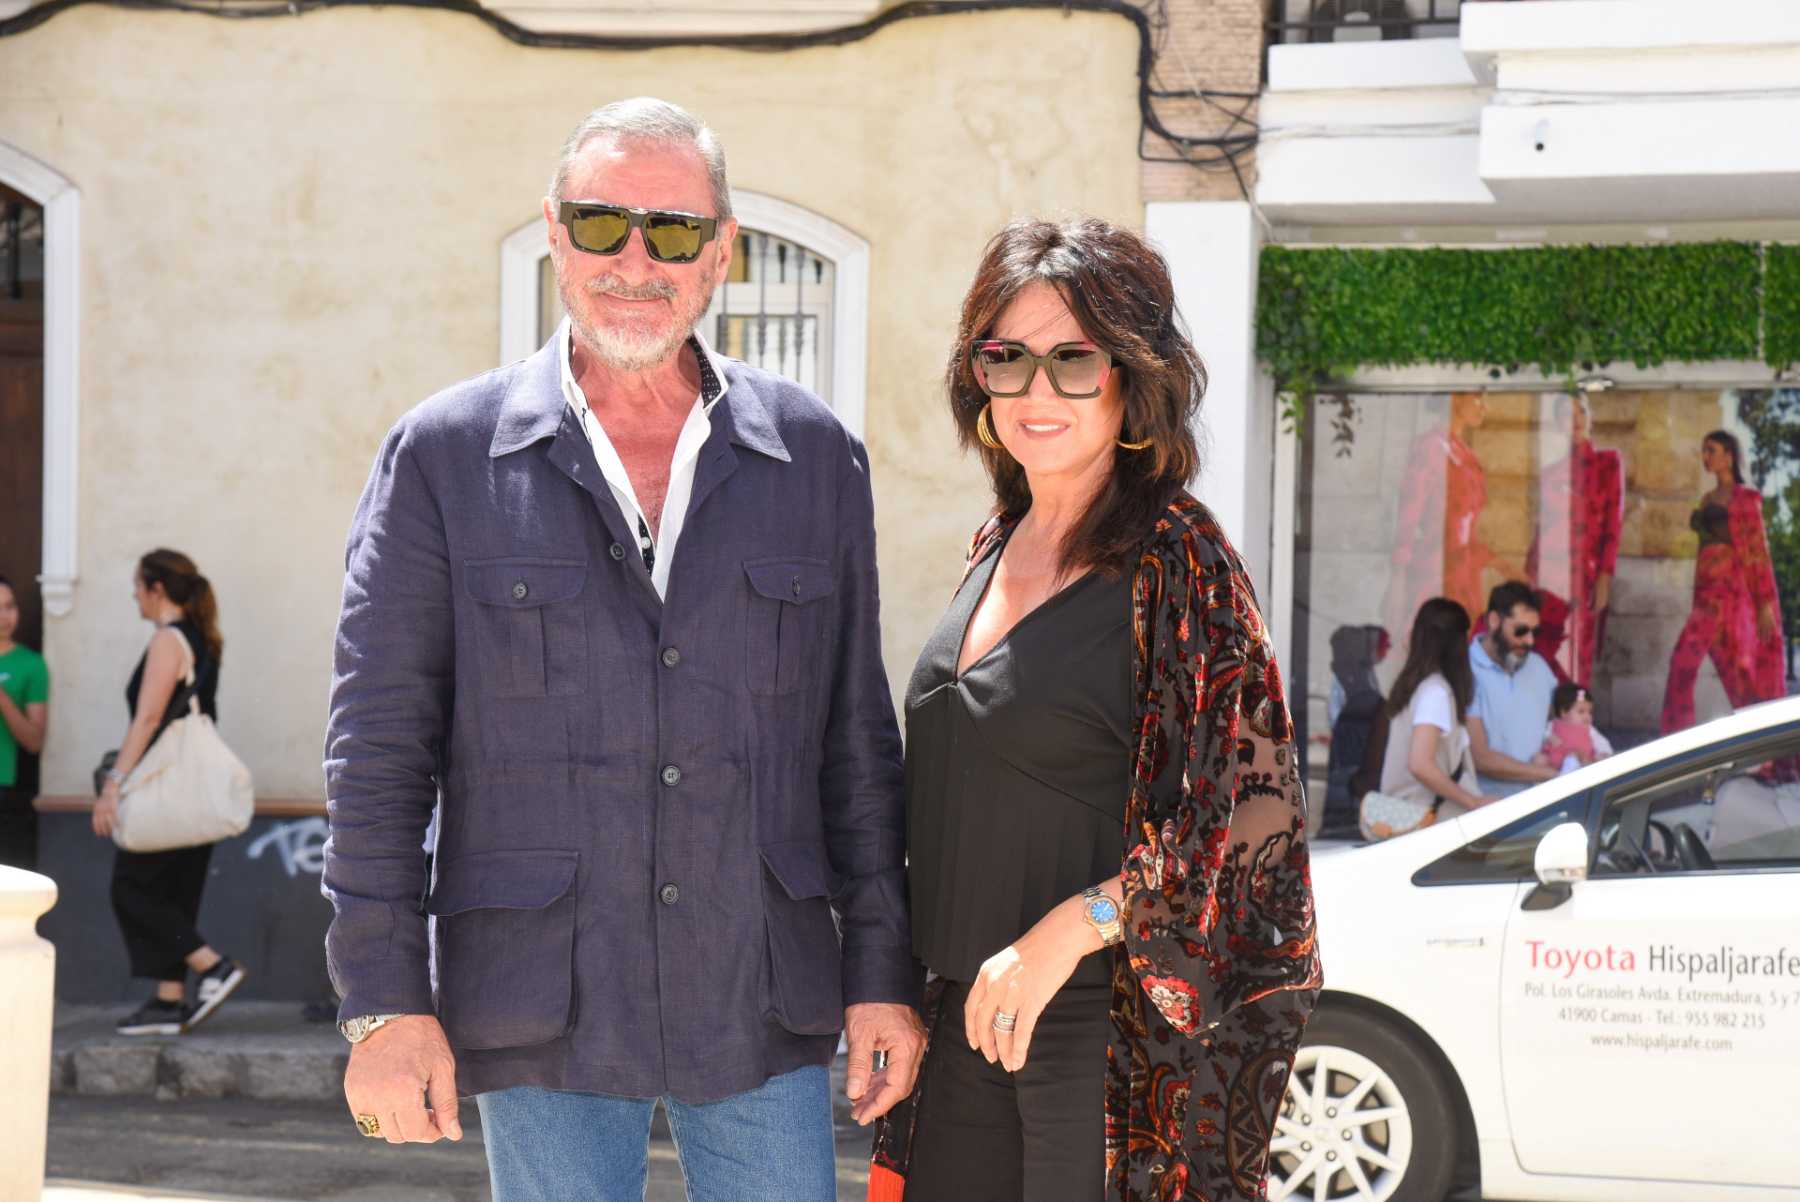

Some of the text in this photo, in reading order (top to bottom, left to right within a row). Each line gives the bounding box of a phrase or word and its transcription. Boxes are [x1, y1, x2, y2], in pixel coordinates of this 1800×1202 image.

[1524, 940, 1800, 983] Toyota Hispaljarafe
[1524, 981, 1546, 998] Pol.
[1551, 983, 1573, 999] Los
[1576, 984, 1634, 1001] Girasoles
[1638, 985, 1672, 1002] Avda.
[1677, 986, 1765, 1007] Extremadura,
[1769, 989, 1778, 1006] 5
[1781, 993, 1791, 1010] y
[1558, 1007, 1598, 1023] 41900
[1600, 1008, 1644, 1025] Camas
[1685, 1010, 1710, 1028] 955
[1713, 1011, 1738, 1029] 982
[1741, 1012, 1767, 1030] 215
[1590, 1032, 1733, 1053] www.hispaljarafe.com
